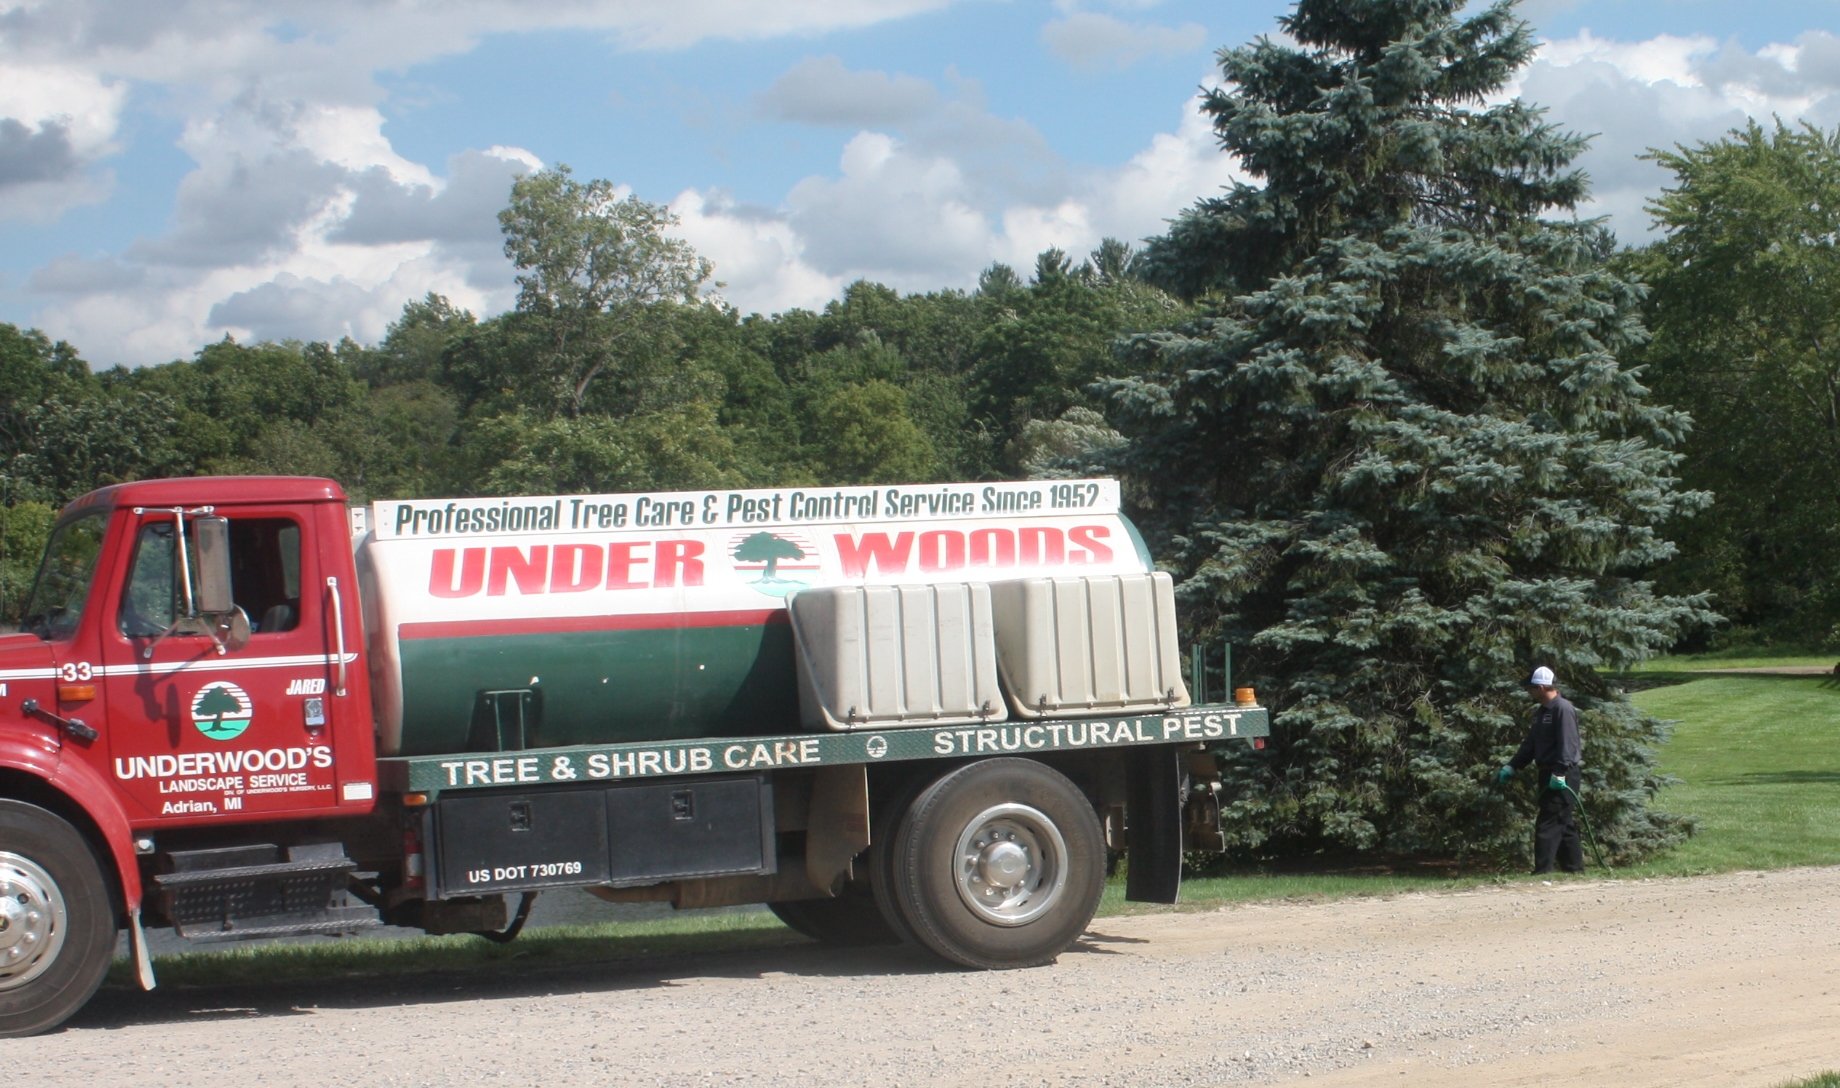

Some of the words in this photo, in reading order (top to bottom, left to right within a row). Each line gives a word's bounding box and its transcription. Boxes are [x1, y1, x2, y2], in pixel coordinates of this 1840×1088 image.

[396, 500, 560, 535] Professional
[570, 499, 628, 529] Tree
[635, 497, 694, 526] Care
[702, 495, 718, 524] &
[726, 493, 782, 523] Pest
[790, 490, 877, 521] Control
[885, 488, 974, 517] Service
[982, 486, 1041, 513] Since
[1049, 483, 1099, 509] 1952
[833, 525, 1113, 577] WOODS
[428, 539, 705, 598] UNDER
[63, 661, 92, 682] 33
[285, 678, 325, 695] JARED
[934, 720, 1153, 755] STRUCTURAL
[1163, 713, 1242, 740] PEST
[115, 746, 332, 780] UNDERWOOD'S
[441, 757, 540, 786] TREE
[552, 756, 577, 780] &
[588, 748, 712, 778] SHRUB
[724, 739, 821, 769] CARE
[159, 776, 244, 794] LANDSCAPE
[249, 773, 307, 788] SERVICE
[162, 798, 217, 814] Adrian,
[224, 797, 242, 810] MI
[469, 869, 491, 883] US
[495, 866, 526, 880] DOT
[531, 861, 582, 877] 730769
